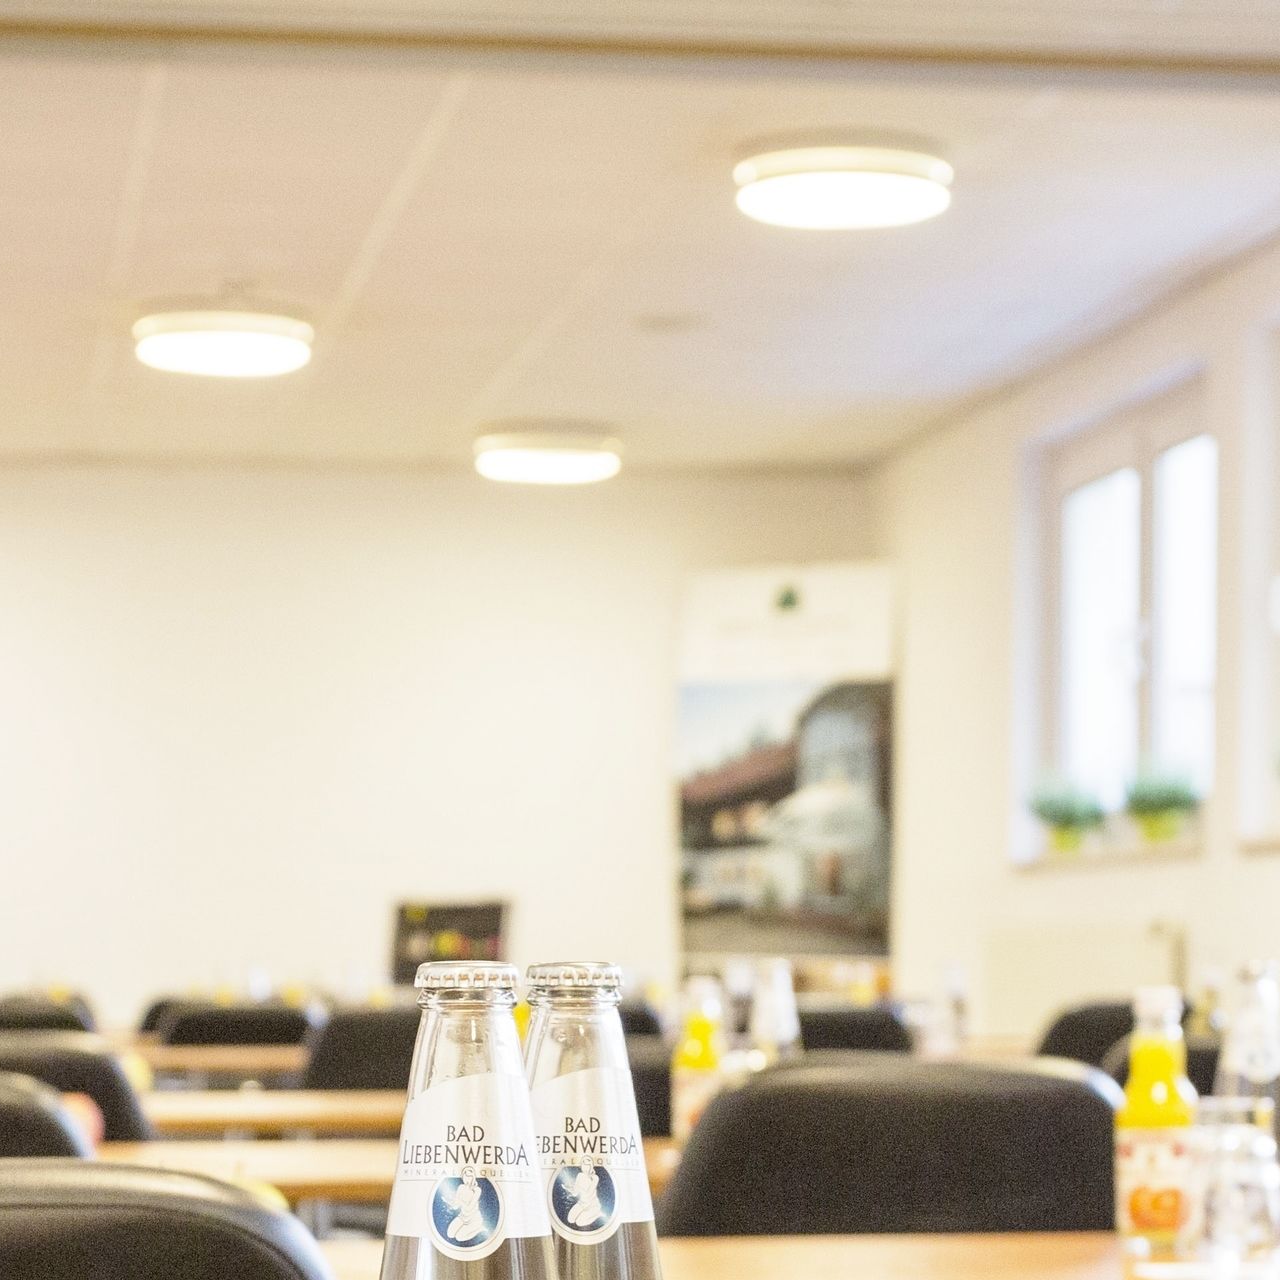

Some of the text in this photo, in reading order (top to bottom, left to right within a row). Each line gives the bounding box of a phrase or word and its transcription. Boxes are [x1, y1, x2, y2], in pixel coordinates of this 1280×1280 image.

[446, 1124, 485, 1143] BAD
[565, 1116, 601, 1133] BAD
[402, 1138, 530, 1167] LIEBENWERDA
